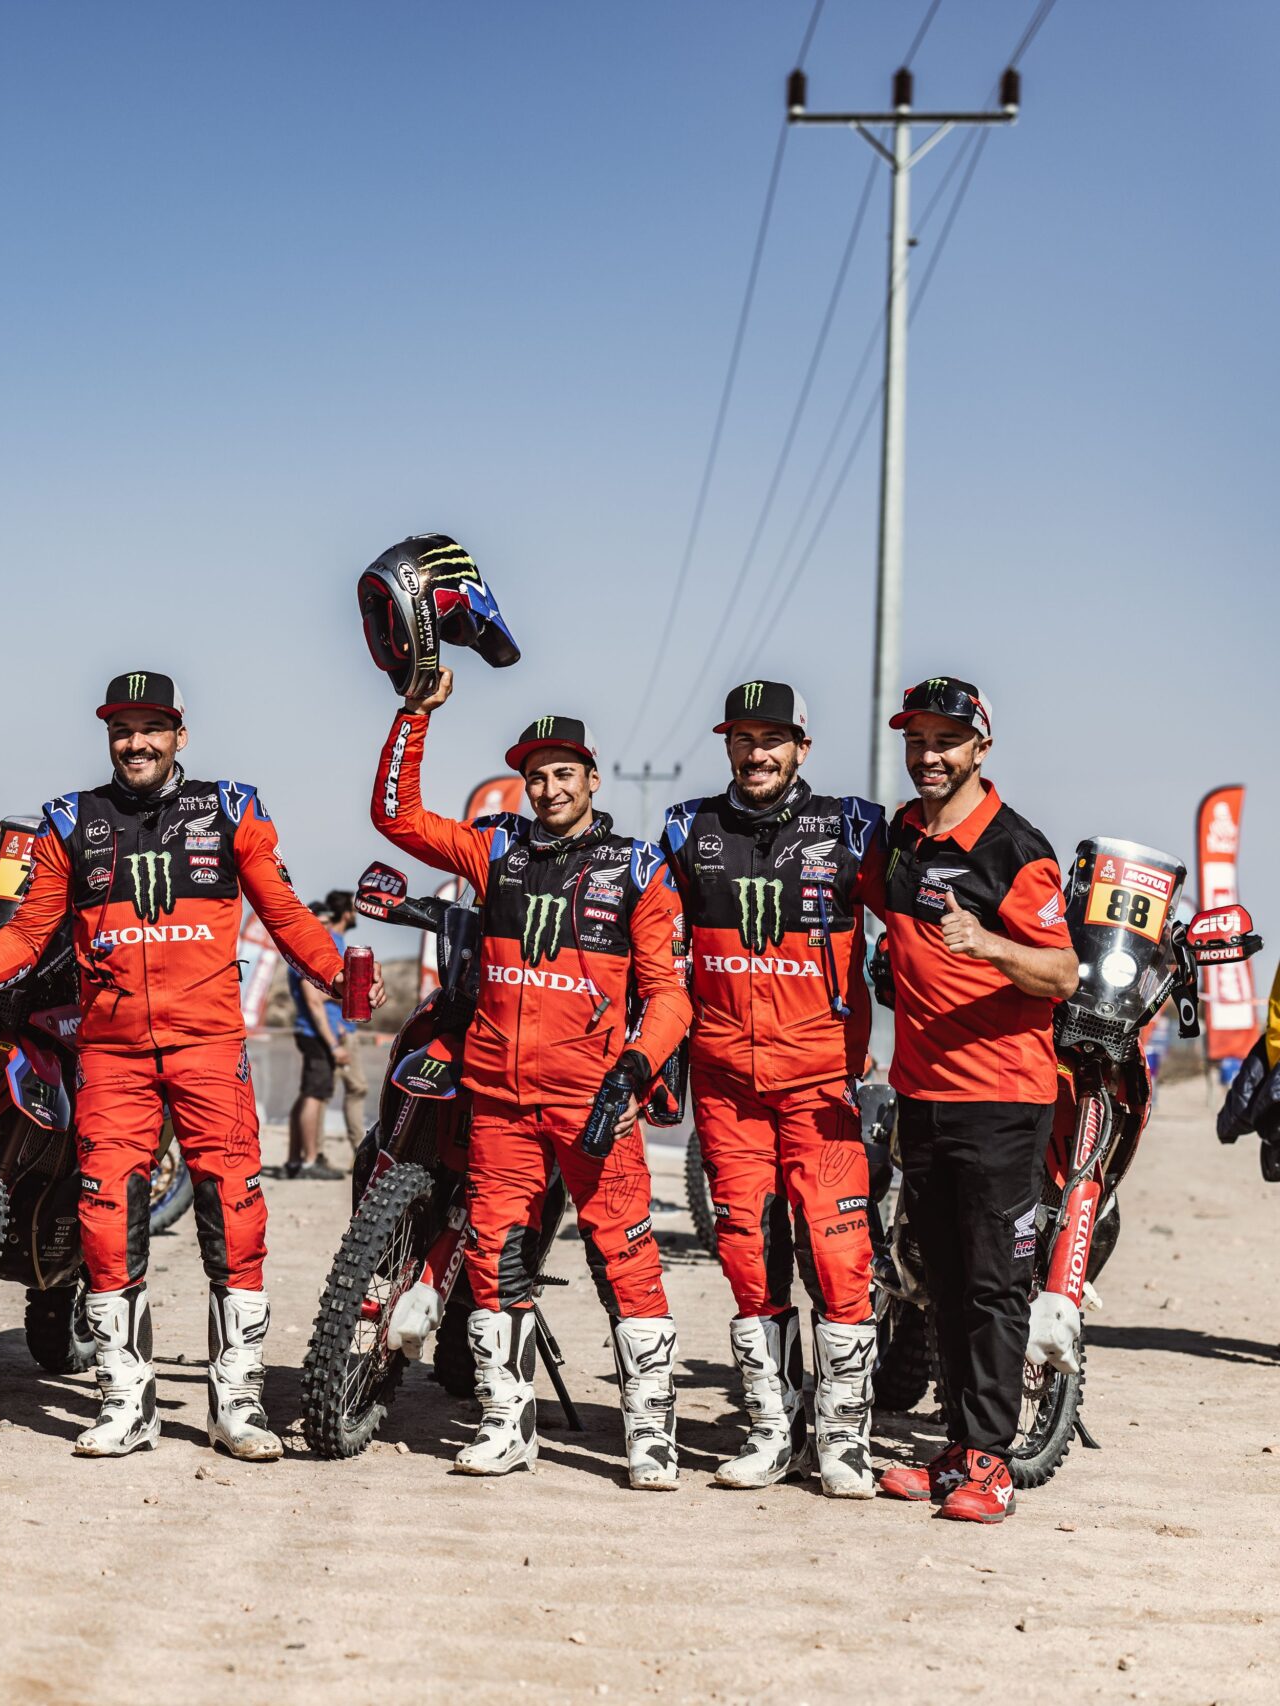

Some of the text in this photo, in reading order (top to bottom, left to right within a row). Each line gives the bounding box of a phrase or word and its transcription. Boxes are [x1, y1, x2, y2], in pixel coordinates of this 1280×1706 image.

[401, 566, 418, 592] Arai
[420, 600, 434, 651] MONSTER
[384, 721, 411, 819] alpinestars
[179, 802, 219, 811] AIR BAG
[797, 824, 841, 835] AIR BAG
[191, 857, 218, 865] MOTUL
[609, 853, 631, 862] BAG
[801, 859, 838, 868] HONDA
[588, 881, 625, 892] HONDA
[921, 877, 954, 892] HONDA
[1125, 870, 1168, 892] MOTUL
[804, 888, 833, 898] MOUL
[356, 899, 384, 917] MOTUL
[586, 908, 617, 921] MOTUL
[1106, 889, 1150, 929] 88
[100, 924, 215, 945] HONDA
[1192, 914, 1241, 935] GIVI
[1200, 948, 1240, 960] MOTUL
[703, 955, 824, 977] HONDA
[487, 964, 601, 996] HONDA
[406, 1075, 438, 1088] HONDA
[234, 1191, 263, 1212] ASTA
[825, 1218, 868, 1237] ASTA
[618, 1235, 653, 1260] ASTA
[1067, 1198, 1093, 1297] HONDA
[440, 1227, 468, 1294] HON
